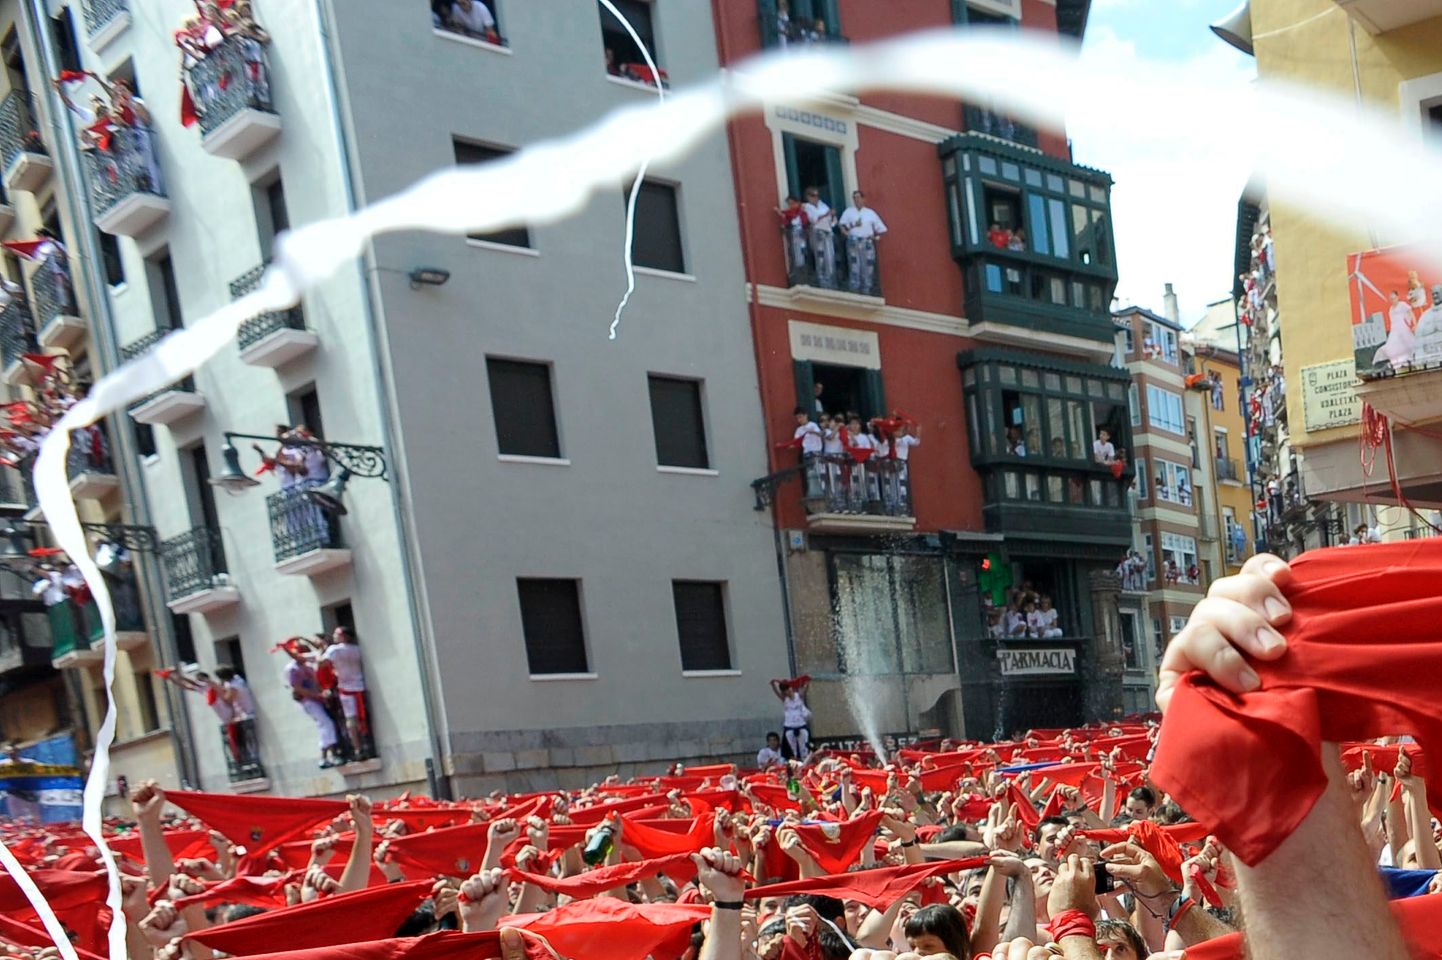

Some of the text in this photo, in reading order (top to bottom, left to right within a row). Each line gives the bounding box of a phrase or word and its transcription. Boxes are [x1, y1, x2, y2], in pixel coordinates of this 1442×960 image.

[1327, 370, 1347, 380] PLAZA
[1329, 408, 1352, 418] PLAZA
[1000, 651, 1072, 672] FARMACIA
